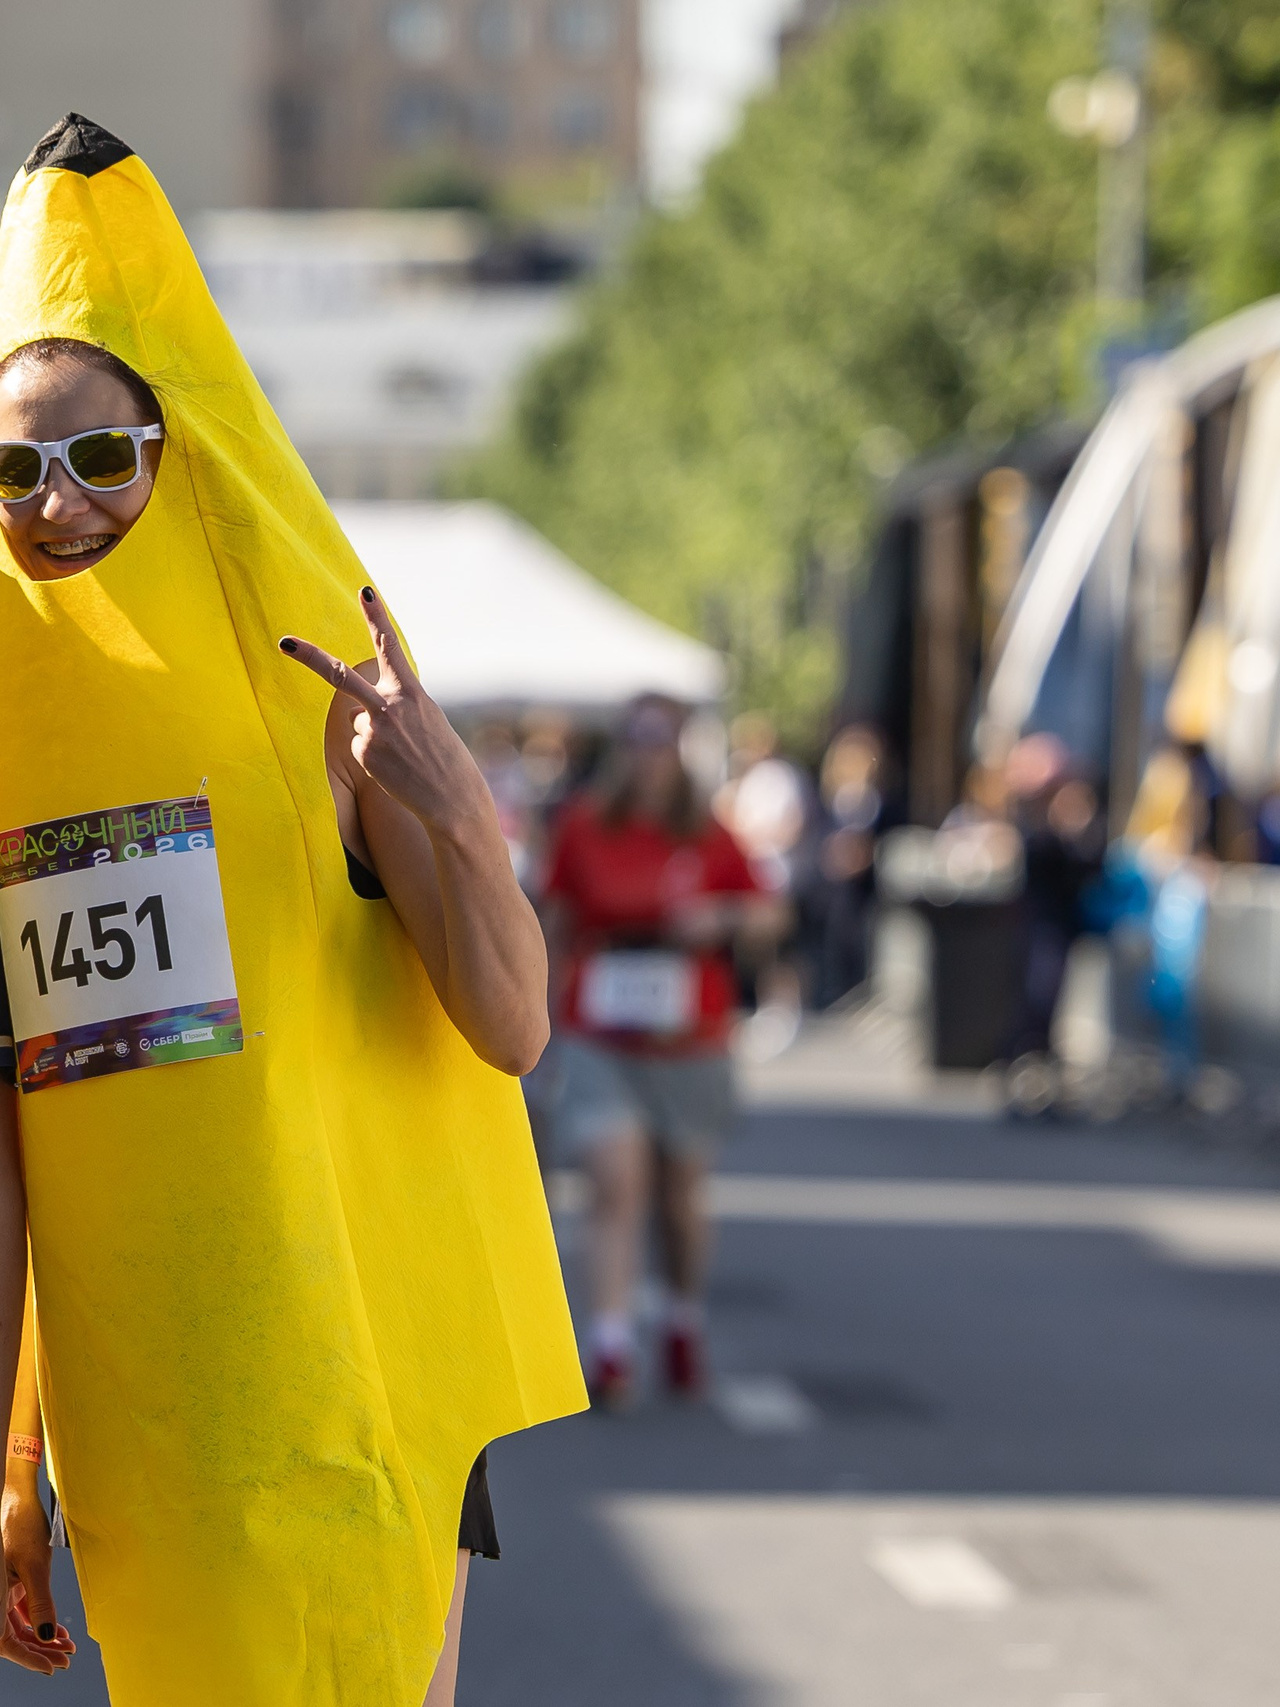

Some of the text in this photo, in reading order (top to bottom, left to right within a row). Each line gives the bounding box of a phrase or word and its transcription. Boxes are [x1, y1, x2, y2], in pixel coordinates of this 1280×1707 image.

[92, 832, 209, 868] 2026
[20, 894, 174, 997] 1451
[152, 1034, 180, 1047] СБЕР
